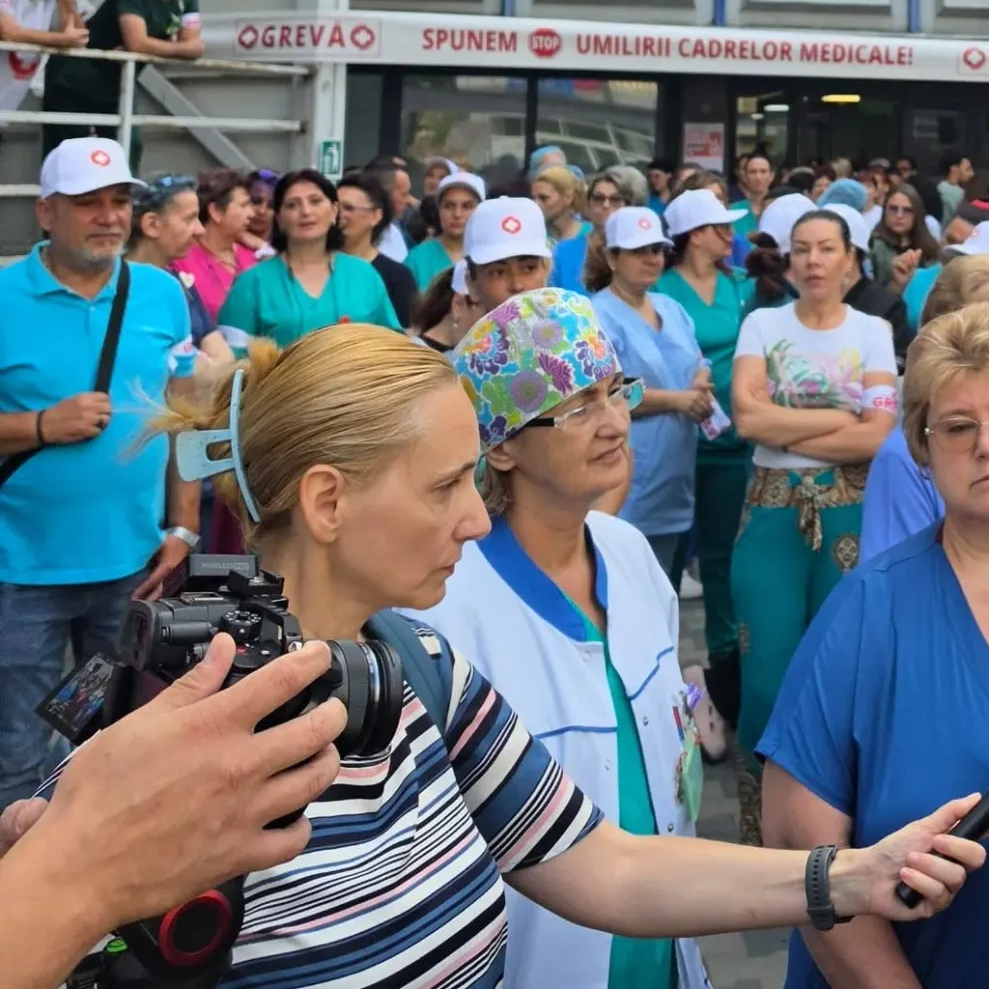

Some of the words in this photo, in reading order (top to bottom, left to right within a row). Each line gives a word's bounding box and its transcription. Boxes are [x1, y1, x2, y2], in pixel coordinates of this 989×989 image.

[422, 27, 518, 53] SPUNEM
[532, 36, 559, 50] STOP
[576, 33, 671, 58] UMILIRII
[678, 37, 793, 61] CADRELOR
[800, 43, 913, 66] MEDICALE!
